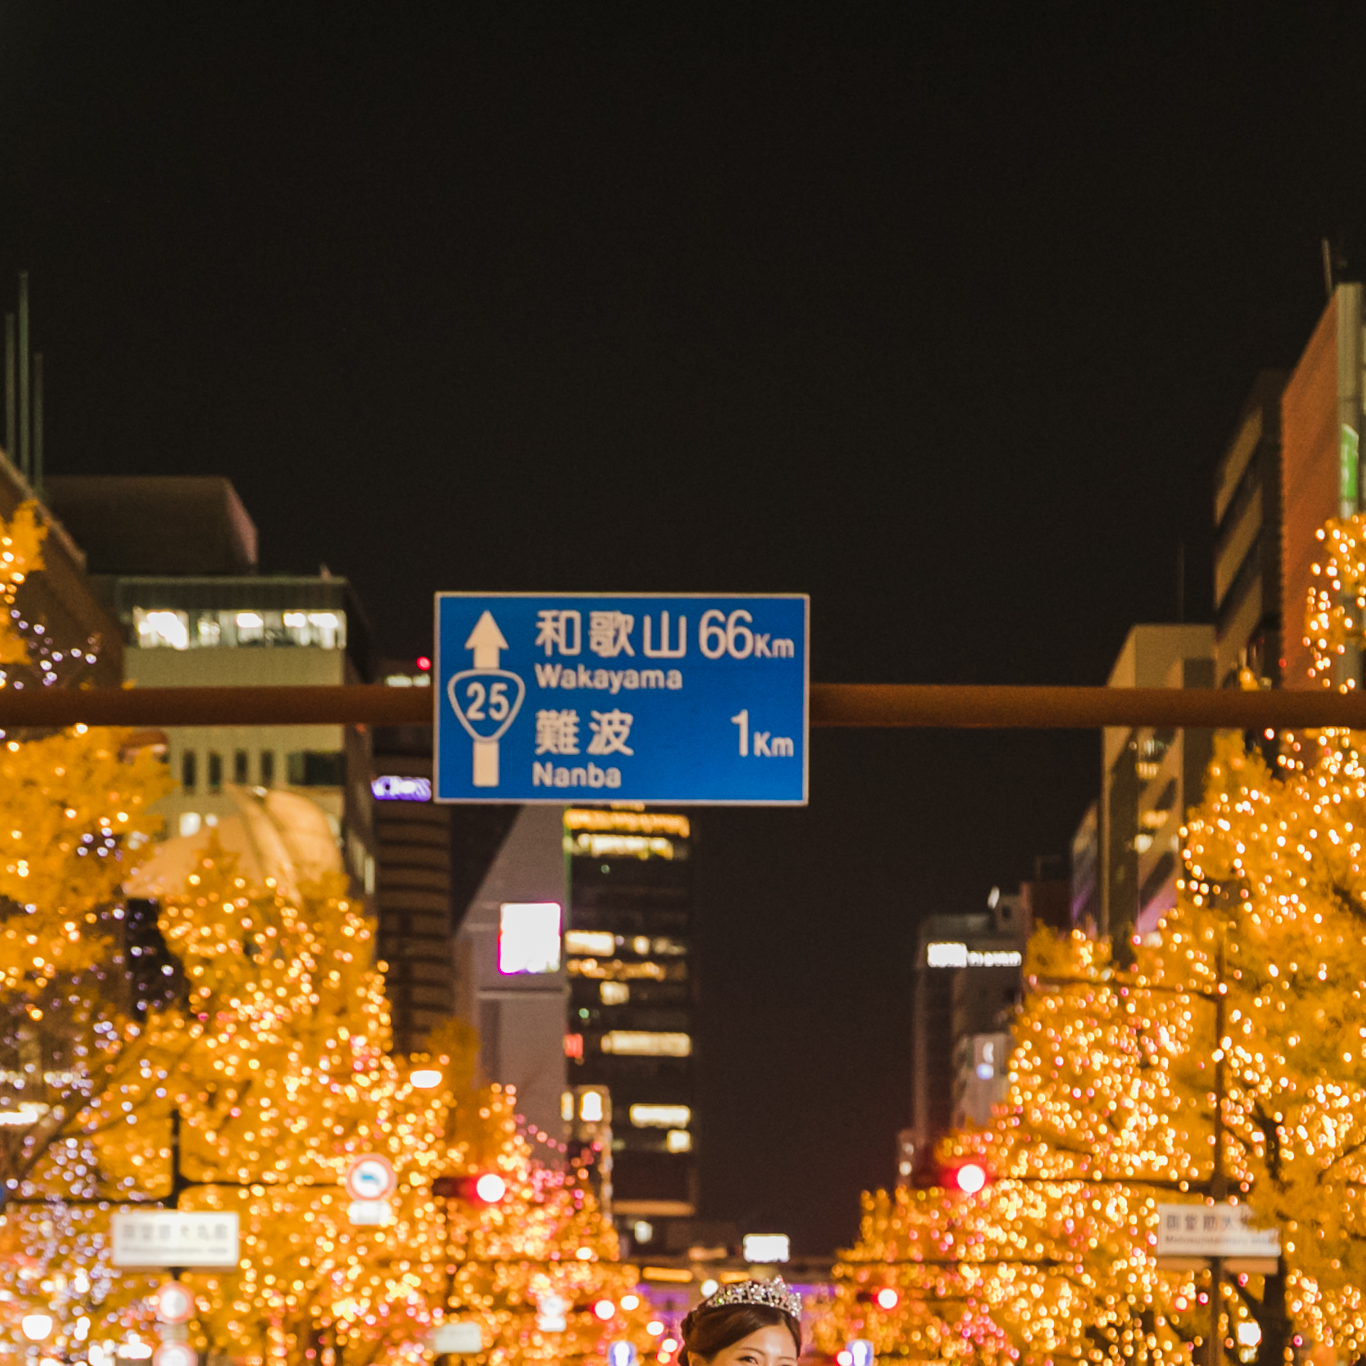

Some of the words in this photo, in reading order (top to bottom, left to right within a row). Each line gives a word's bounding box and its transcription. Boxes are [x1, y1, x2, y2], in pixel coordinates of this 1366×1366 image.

[535, 609, 687, 659] 和歌山
[534, 663, 683, 695] Wakayama
[465, 681, 510, 721] 25
[534, 708, 634, 757] 難波
[533, 762, 622, 789] Nanba
